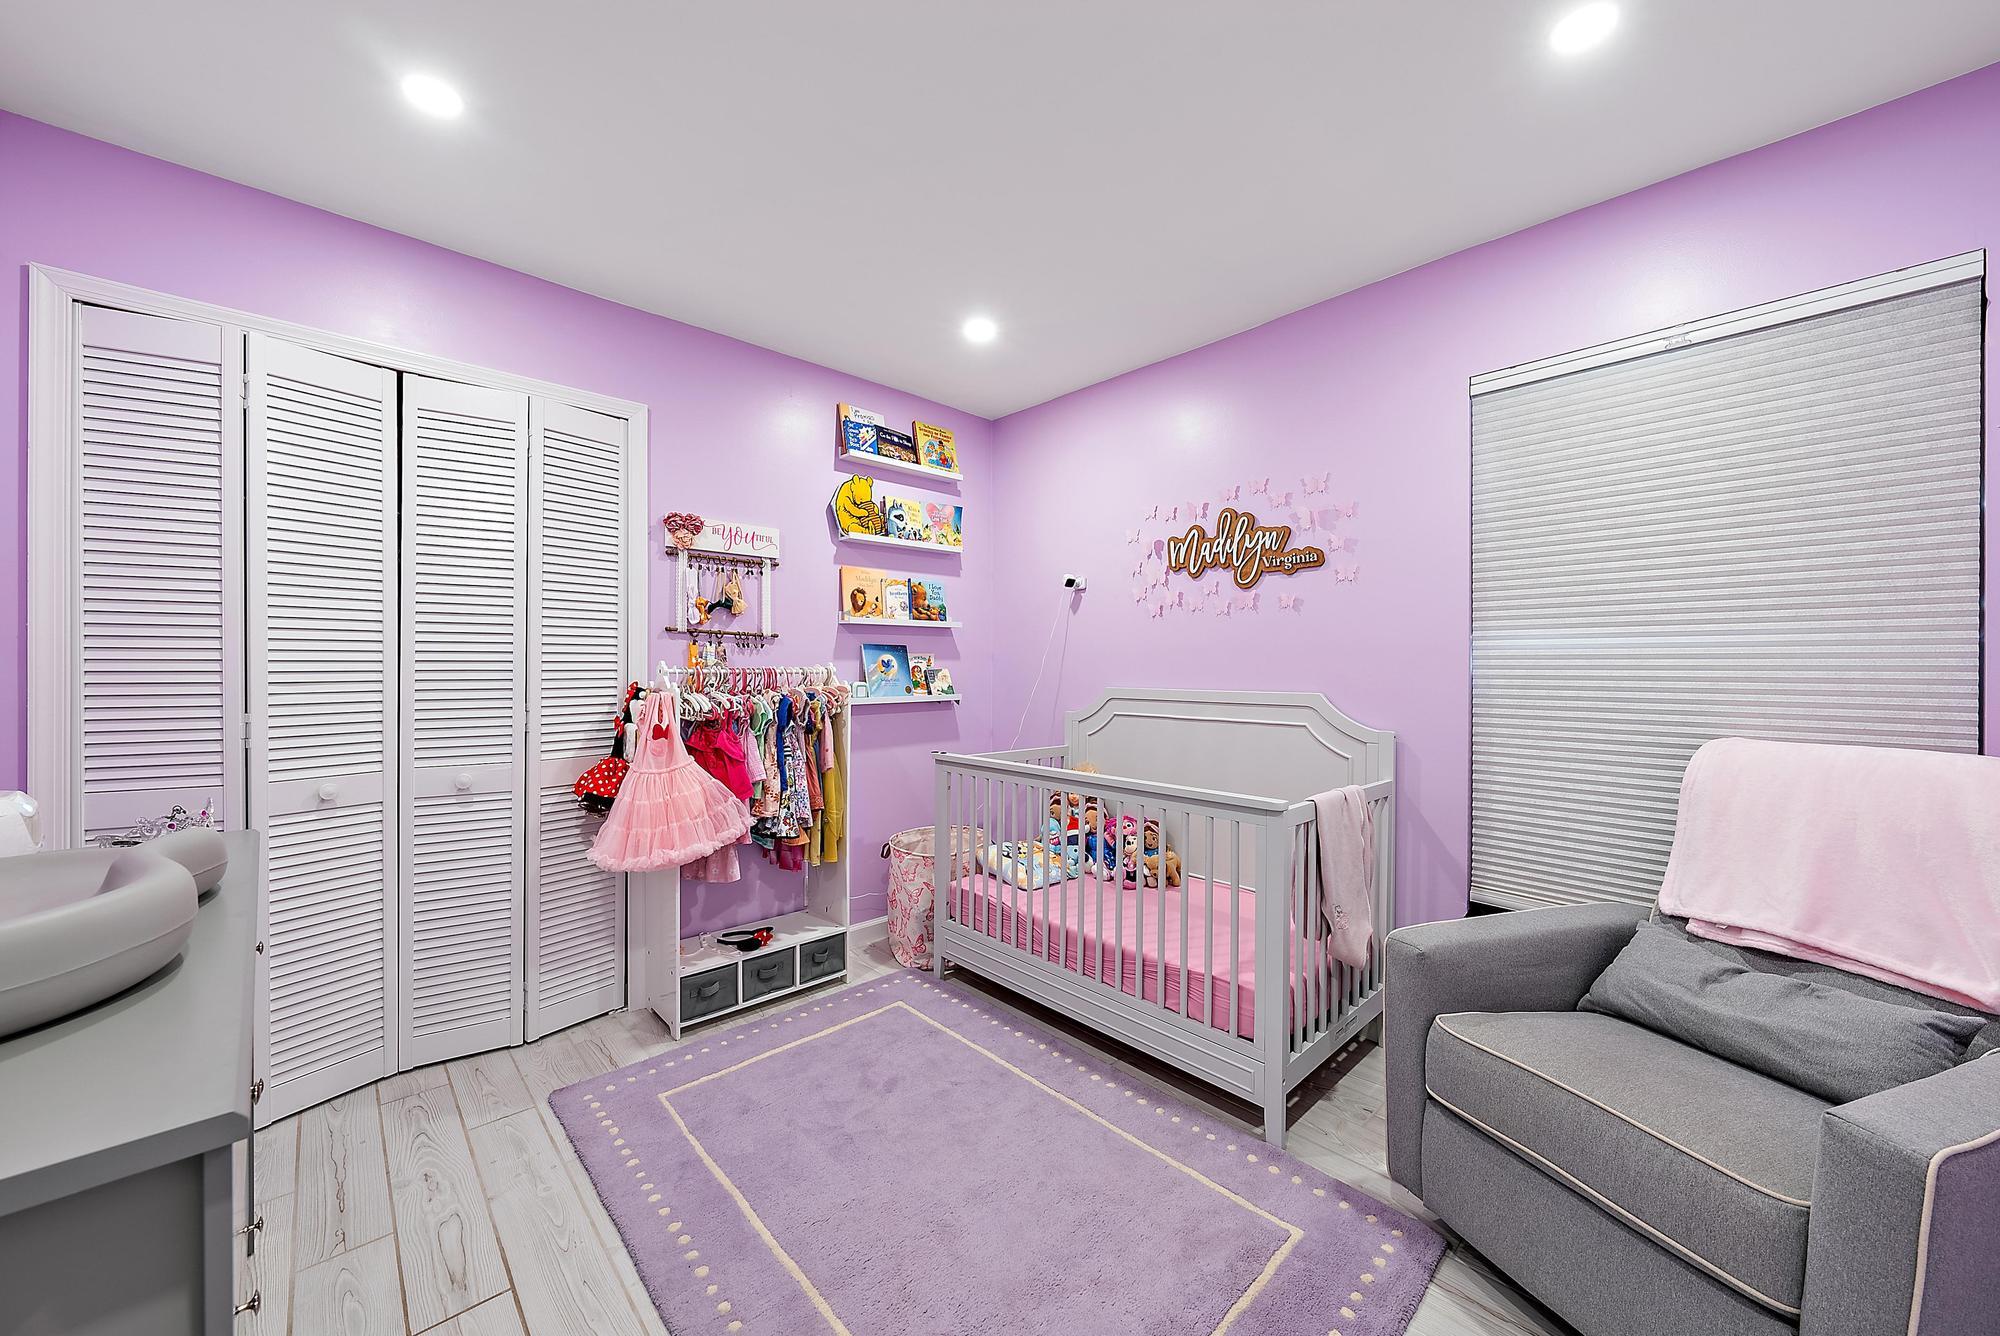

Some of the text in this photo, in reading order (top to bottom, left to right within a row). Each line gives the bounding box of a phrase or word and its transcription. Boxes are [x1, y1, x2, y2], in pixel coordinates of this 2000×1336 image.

[1170, 511, 1284, 584] Madilyn
[1261, 551, 1318, 570] Virginia
[931, 583, 942, 591] Love
[929, 594, 944, 603] Daddy
